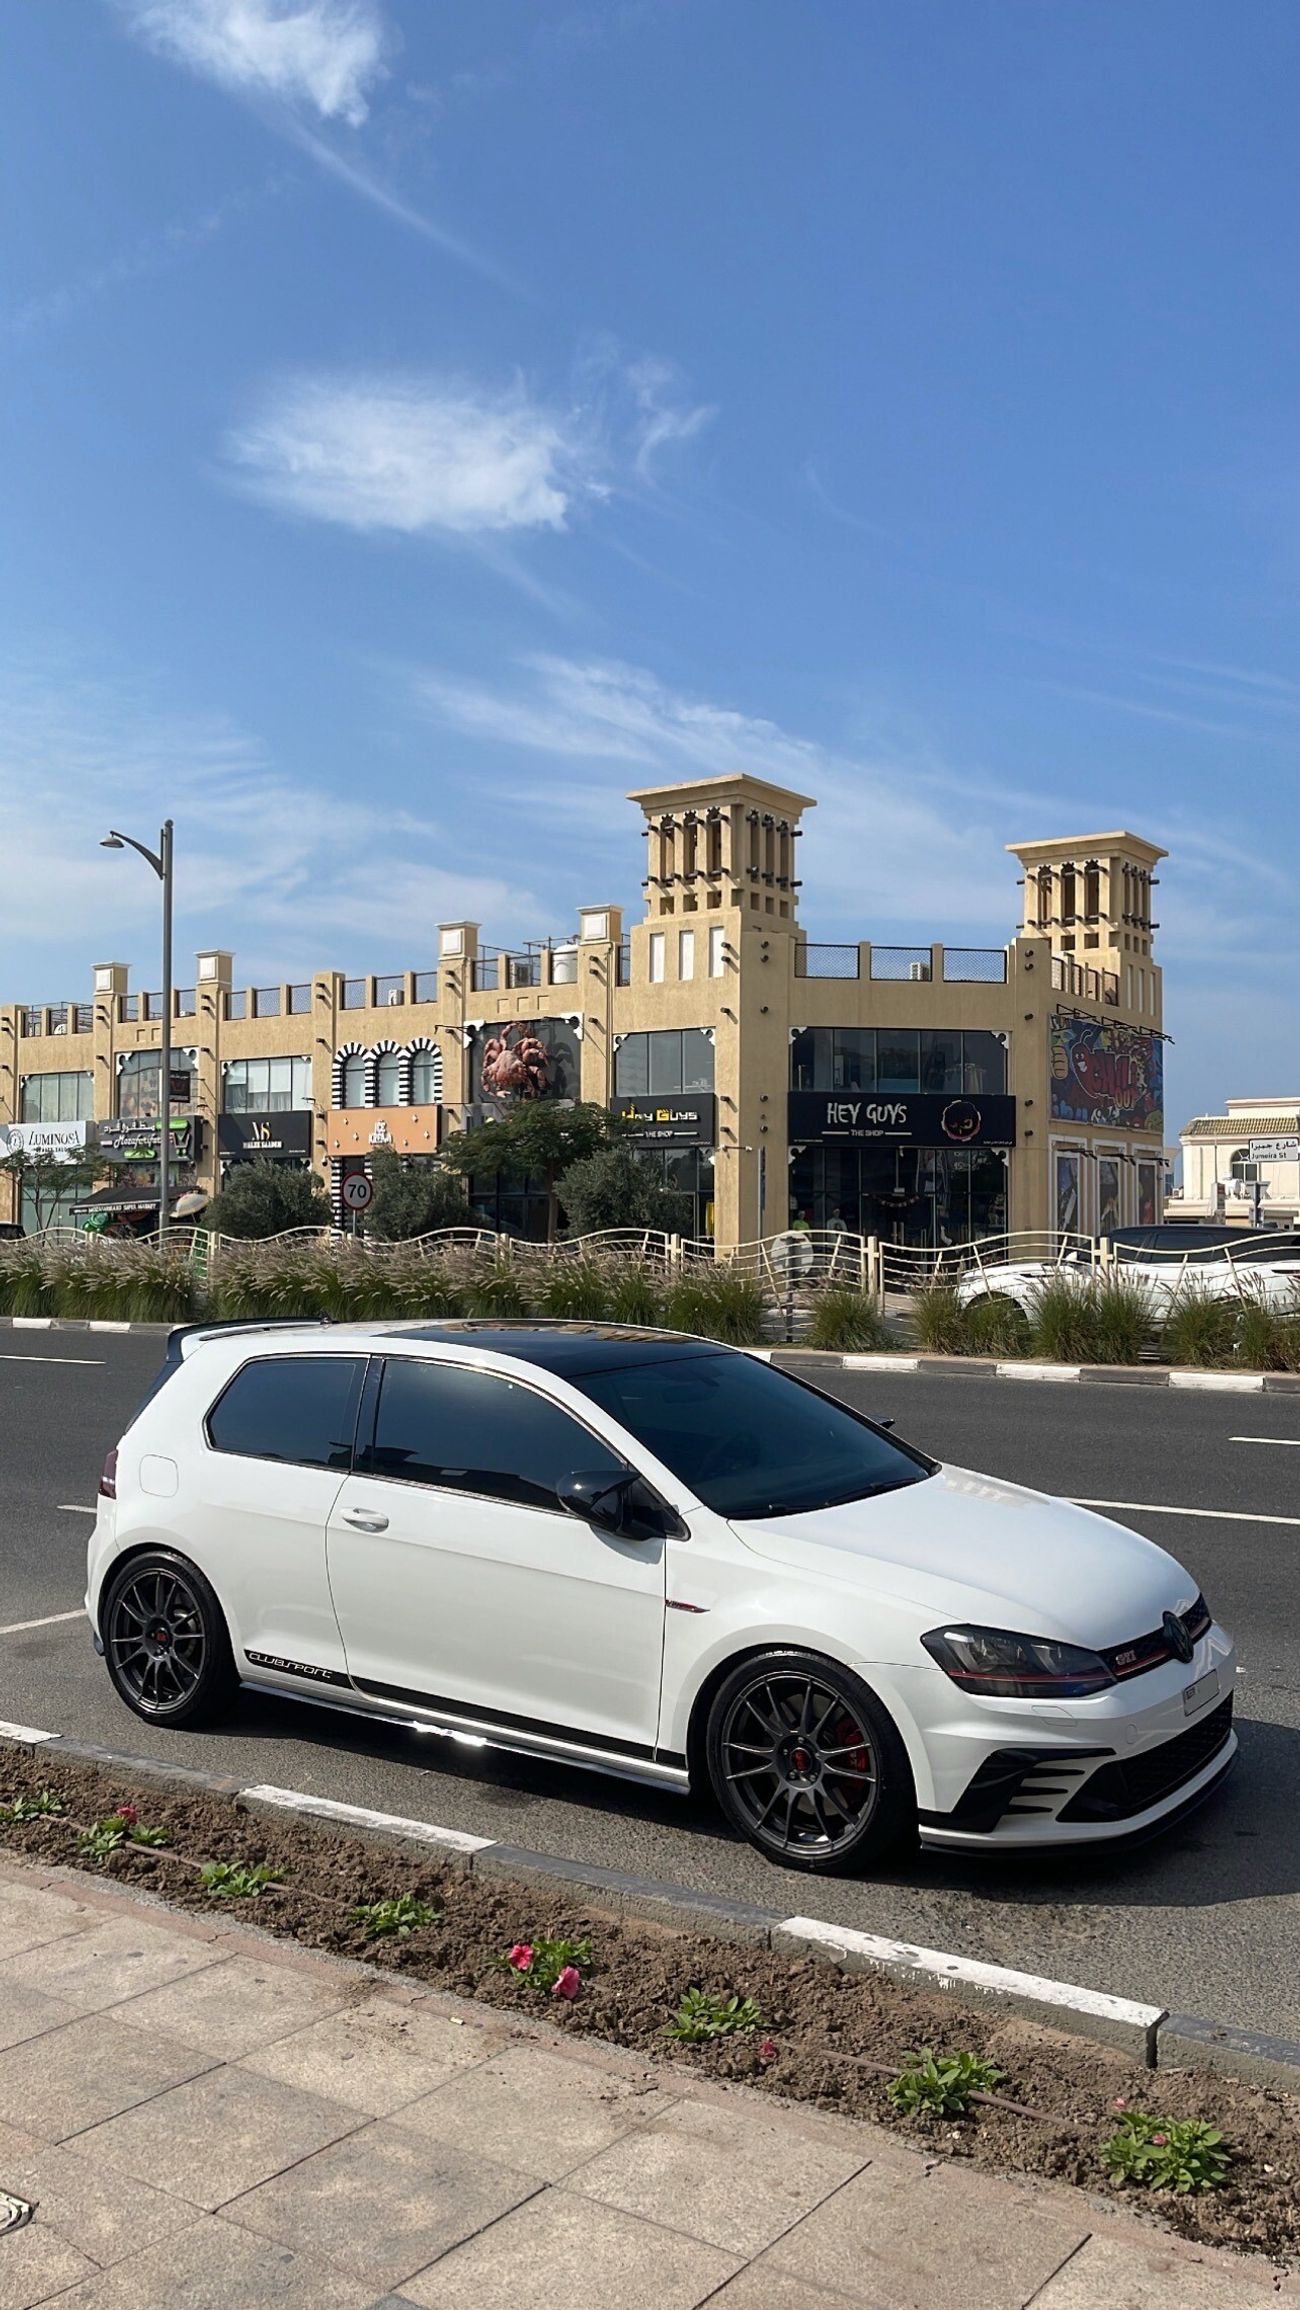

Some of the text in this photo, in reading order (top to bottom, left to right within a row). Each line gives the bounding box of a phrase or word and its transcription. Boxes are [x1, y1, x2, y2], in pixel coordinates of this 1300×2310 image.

[827, 1102, 907, 1125] HEY GUYS
[28, 1130, 80, 1146] LUMINOSA
[850, 1129, 864, 1137] THE
[1276, 1141, 1297, 1150] شارع
[348, 1184, 367, 1199] 70
[248, 1651, 334, 1679] CLUBSPORT
